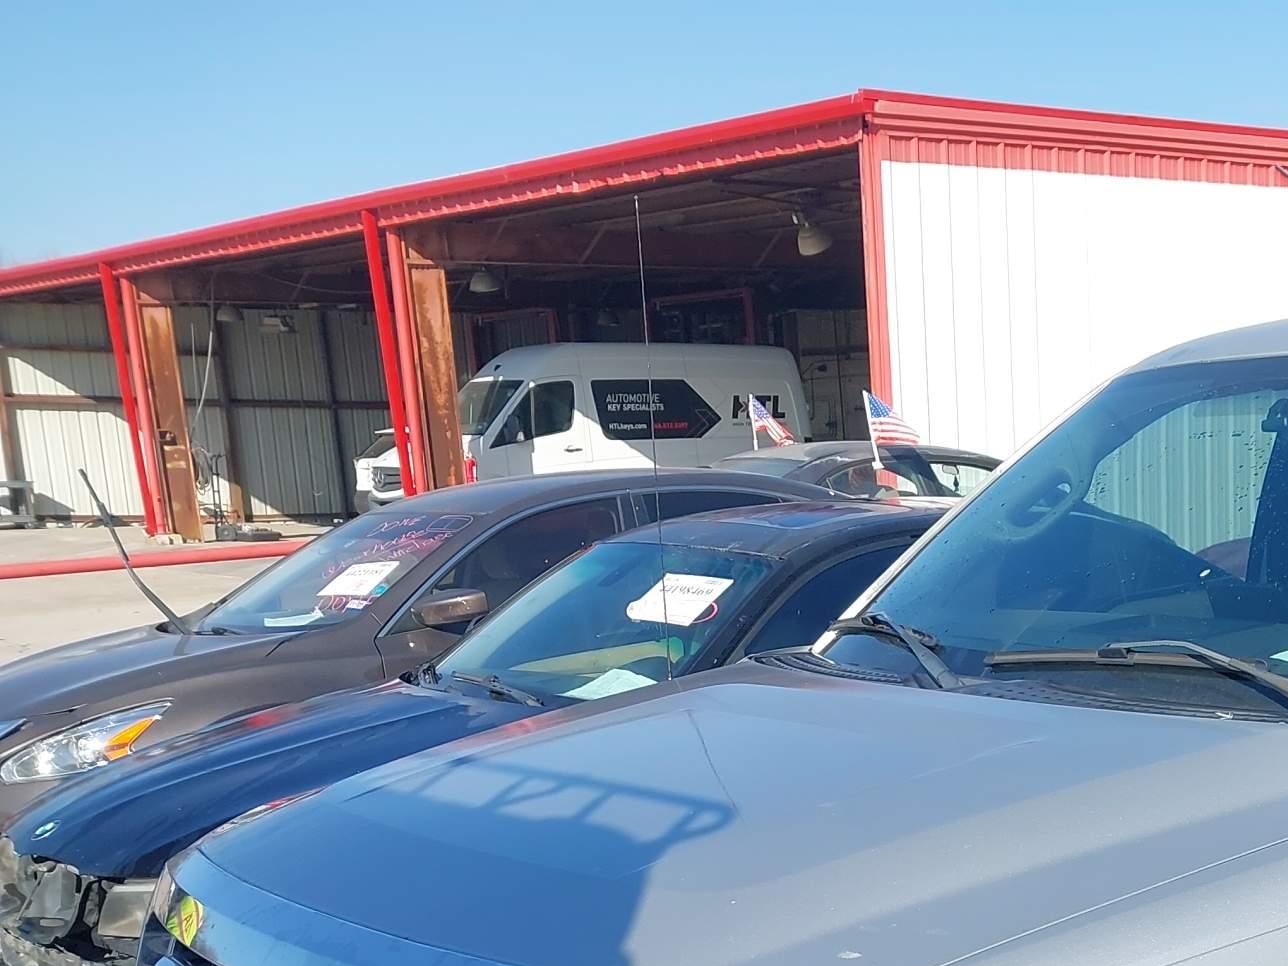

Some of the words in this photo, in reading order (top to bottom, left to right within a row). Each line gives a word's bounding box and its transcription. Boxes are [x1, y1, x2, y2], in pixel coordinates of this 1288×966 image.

[606, 393, 660, 403] AUTOMOTIVE
[608, 403, 622, 411] KEY
[623, 402, 665, 411] SPECIALISTS
[732, 394, 786, 419] HTL
